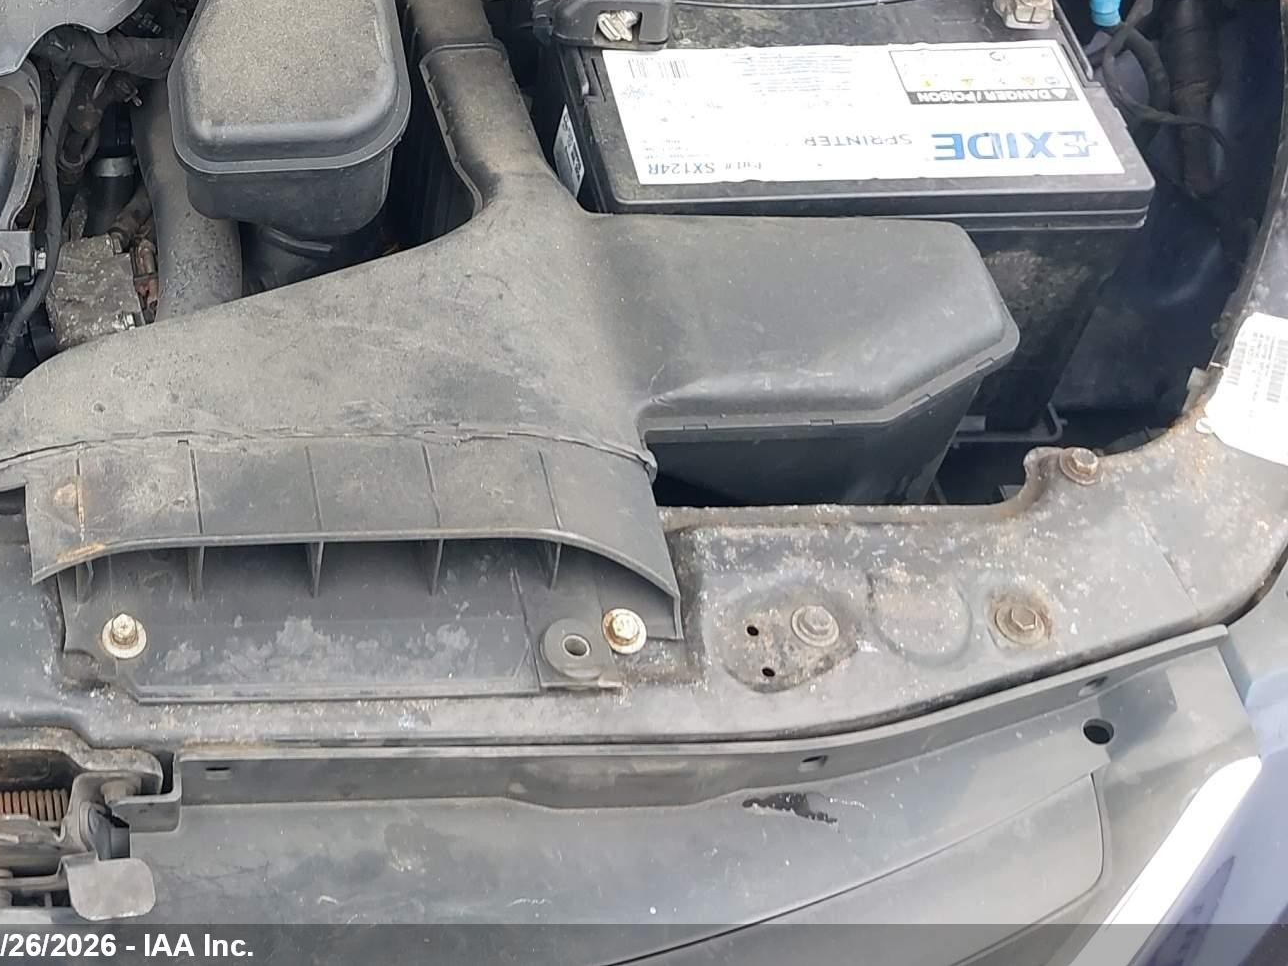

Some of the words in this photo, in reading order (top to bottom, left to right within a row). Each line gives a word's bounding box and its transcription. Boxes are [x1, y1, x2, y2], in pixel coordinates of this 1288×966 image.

[917, 90, 976, 103] POISON
[984, 88, 1052, 101] DANGER
[804, 133, 913, 146] SPRINTER
[931, 131, 1094, 160] EXIDE
[648, 161, 715, 175] SX124R
